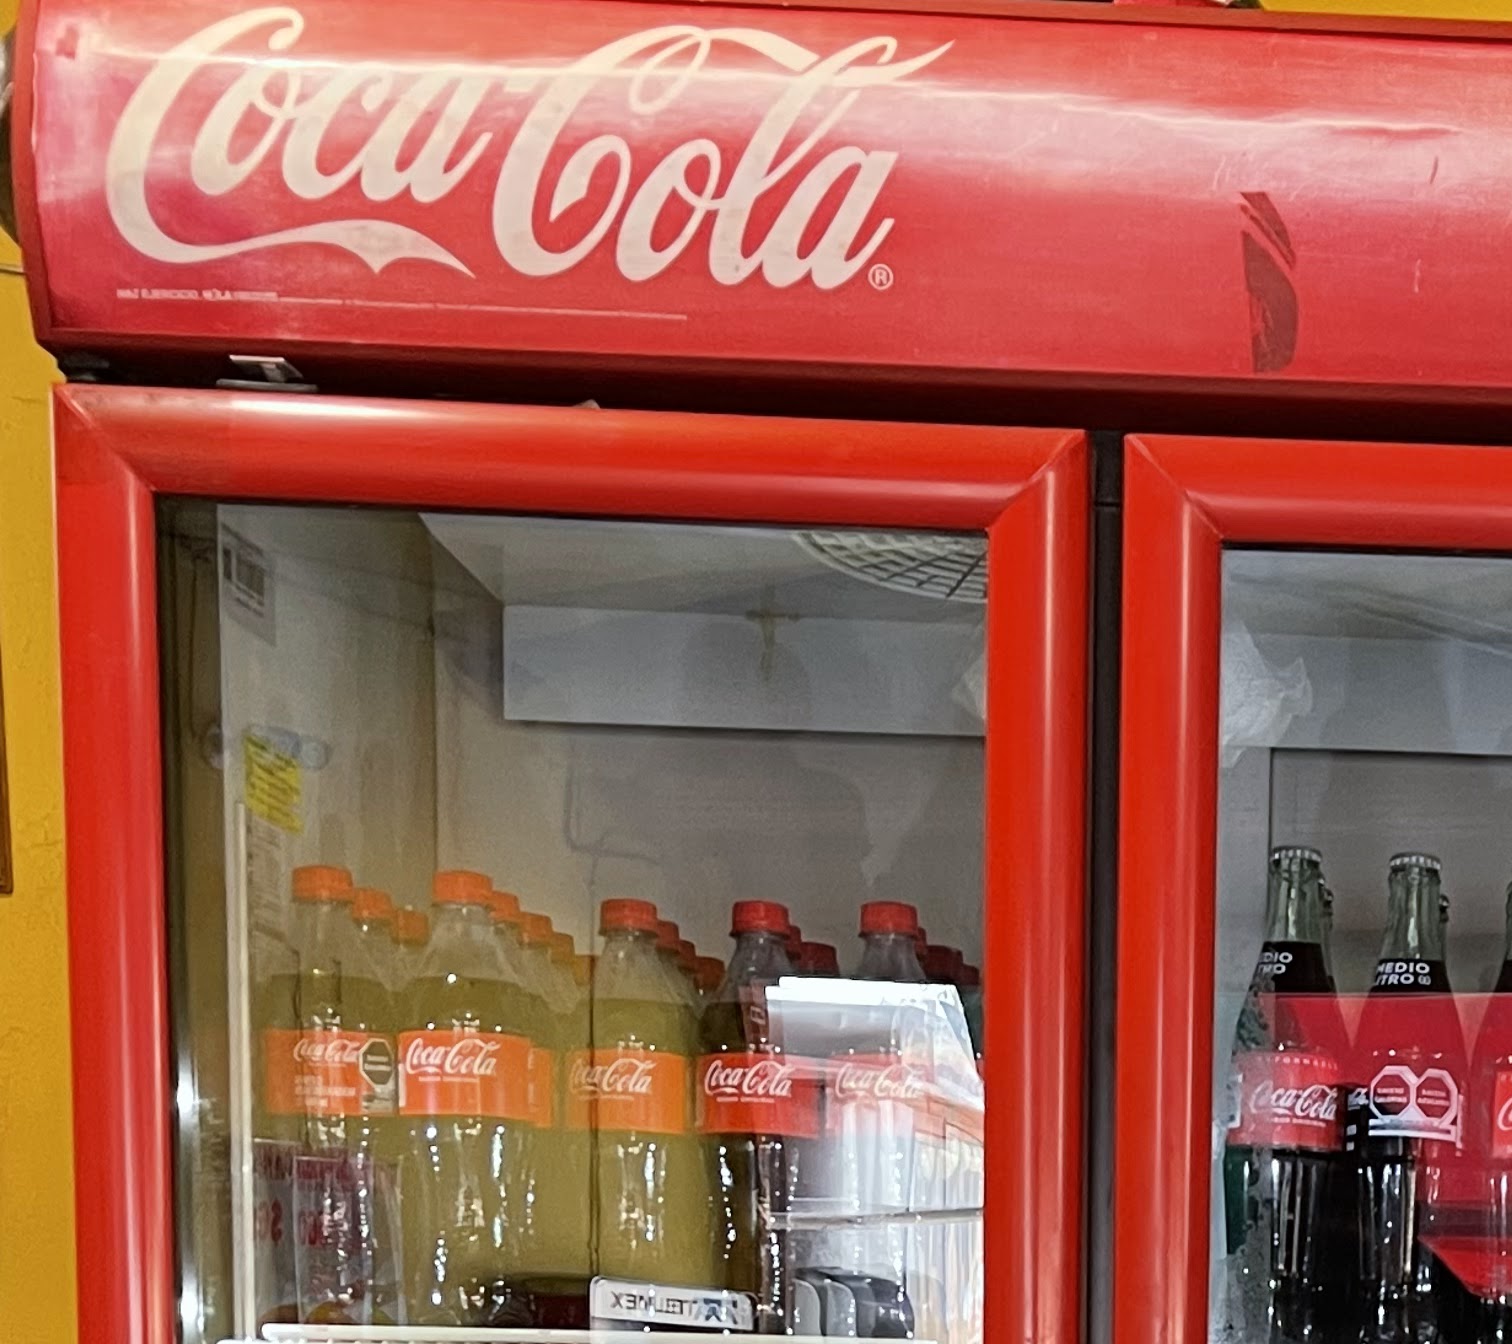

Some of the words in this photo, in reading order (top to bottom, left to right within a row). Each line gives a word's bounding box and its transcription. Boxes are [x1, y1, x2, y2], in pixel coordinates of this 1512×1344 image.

[106, 7, 955, 290] Coca-Cola
[1375, 973, 1415, 986] ITRO
[406, 1037, 501, 1076] Coca-Cola
[704, 1060, 793, 1097] Coca-Cola
